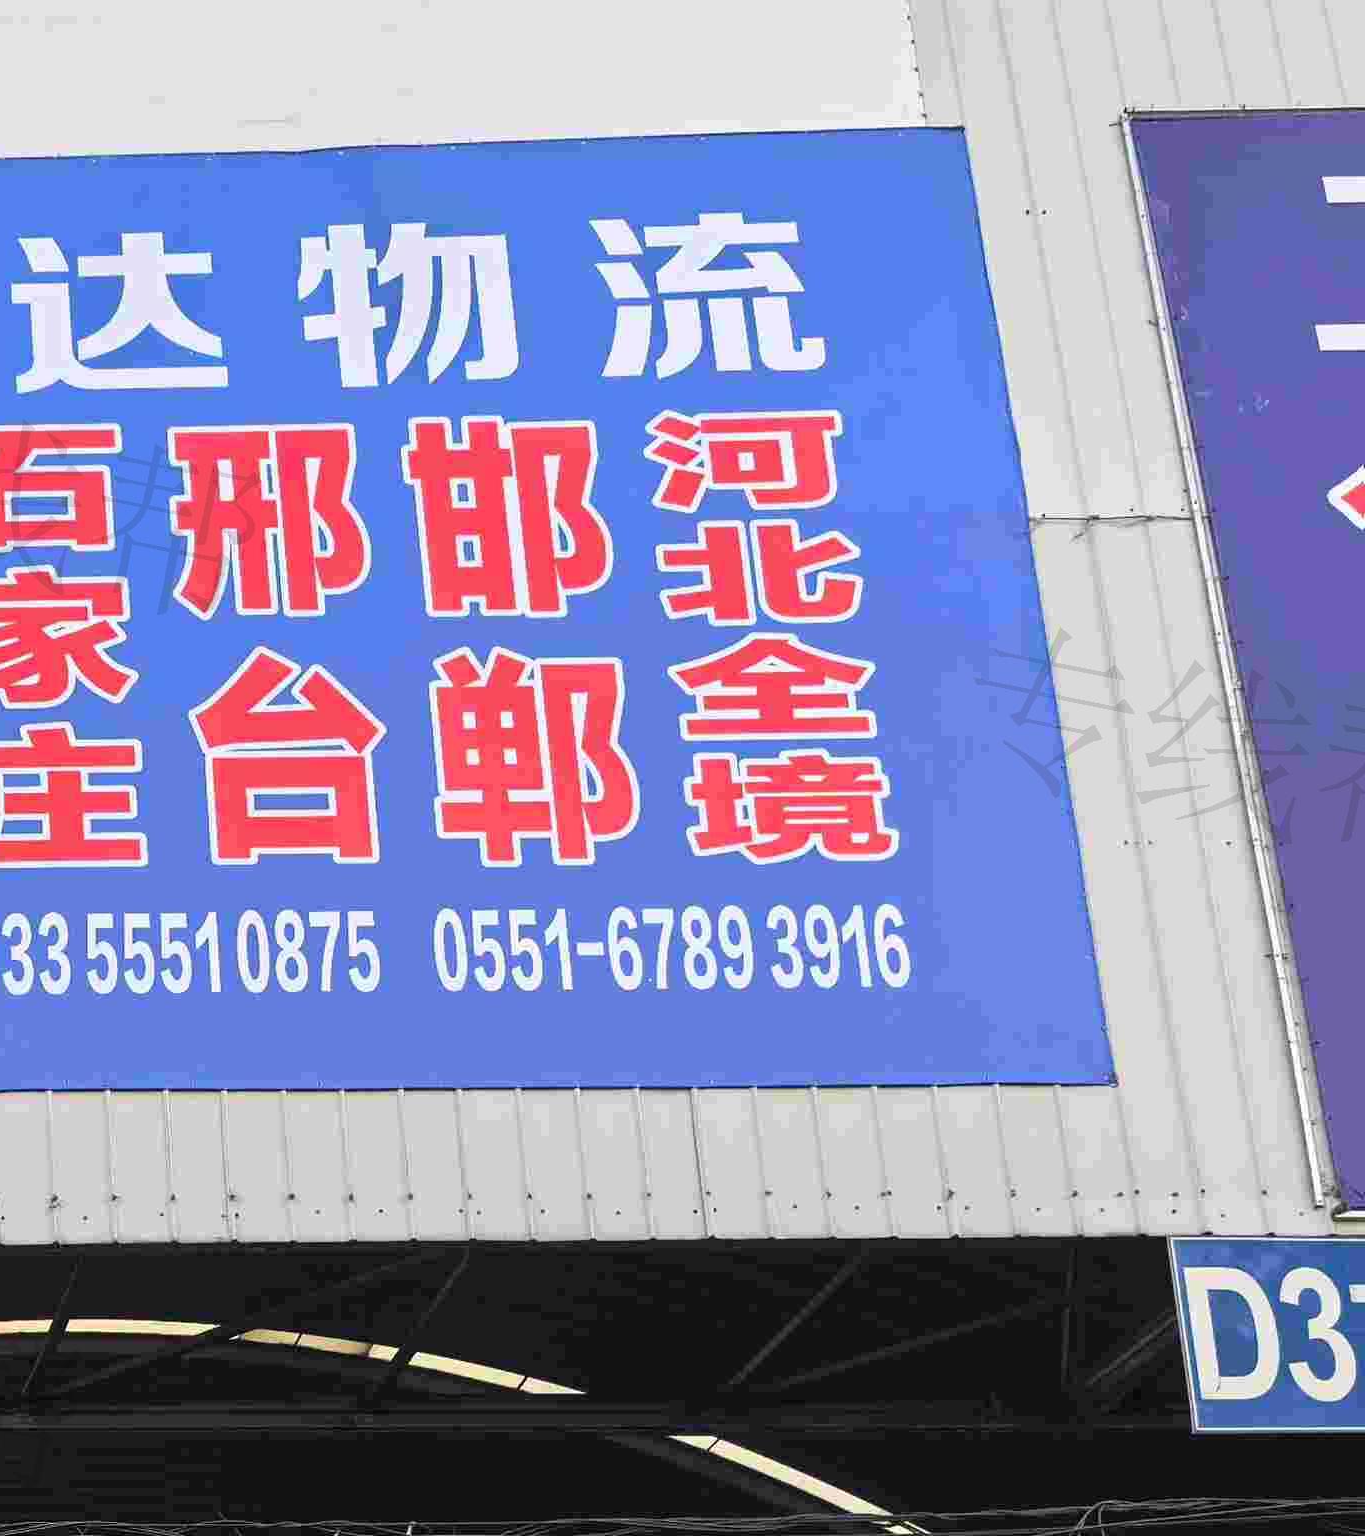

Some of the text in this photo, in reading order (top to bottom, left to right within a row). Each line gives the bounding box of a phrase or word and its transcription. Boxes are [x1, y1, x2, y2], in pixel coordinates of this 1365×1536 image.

[168, 423, 386, 865] 邢台
[401, 416, 643, 867] 邯郸
[645, 410, 899, 864] 河北全境
[1183, 1266, 1365, 1402] D3
